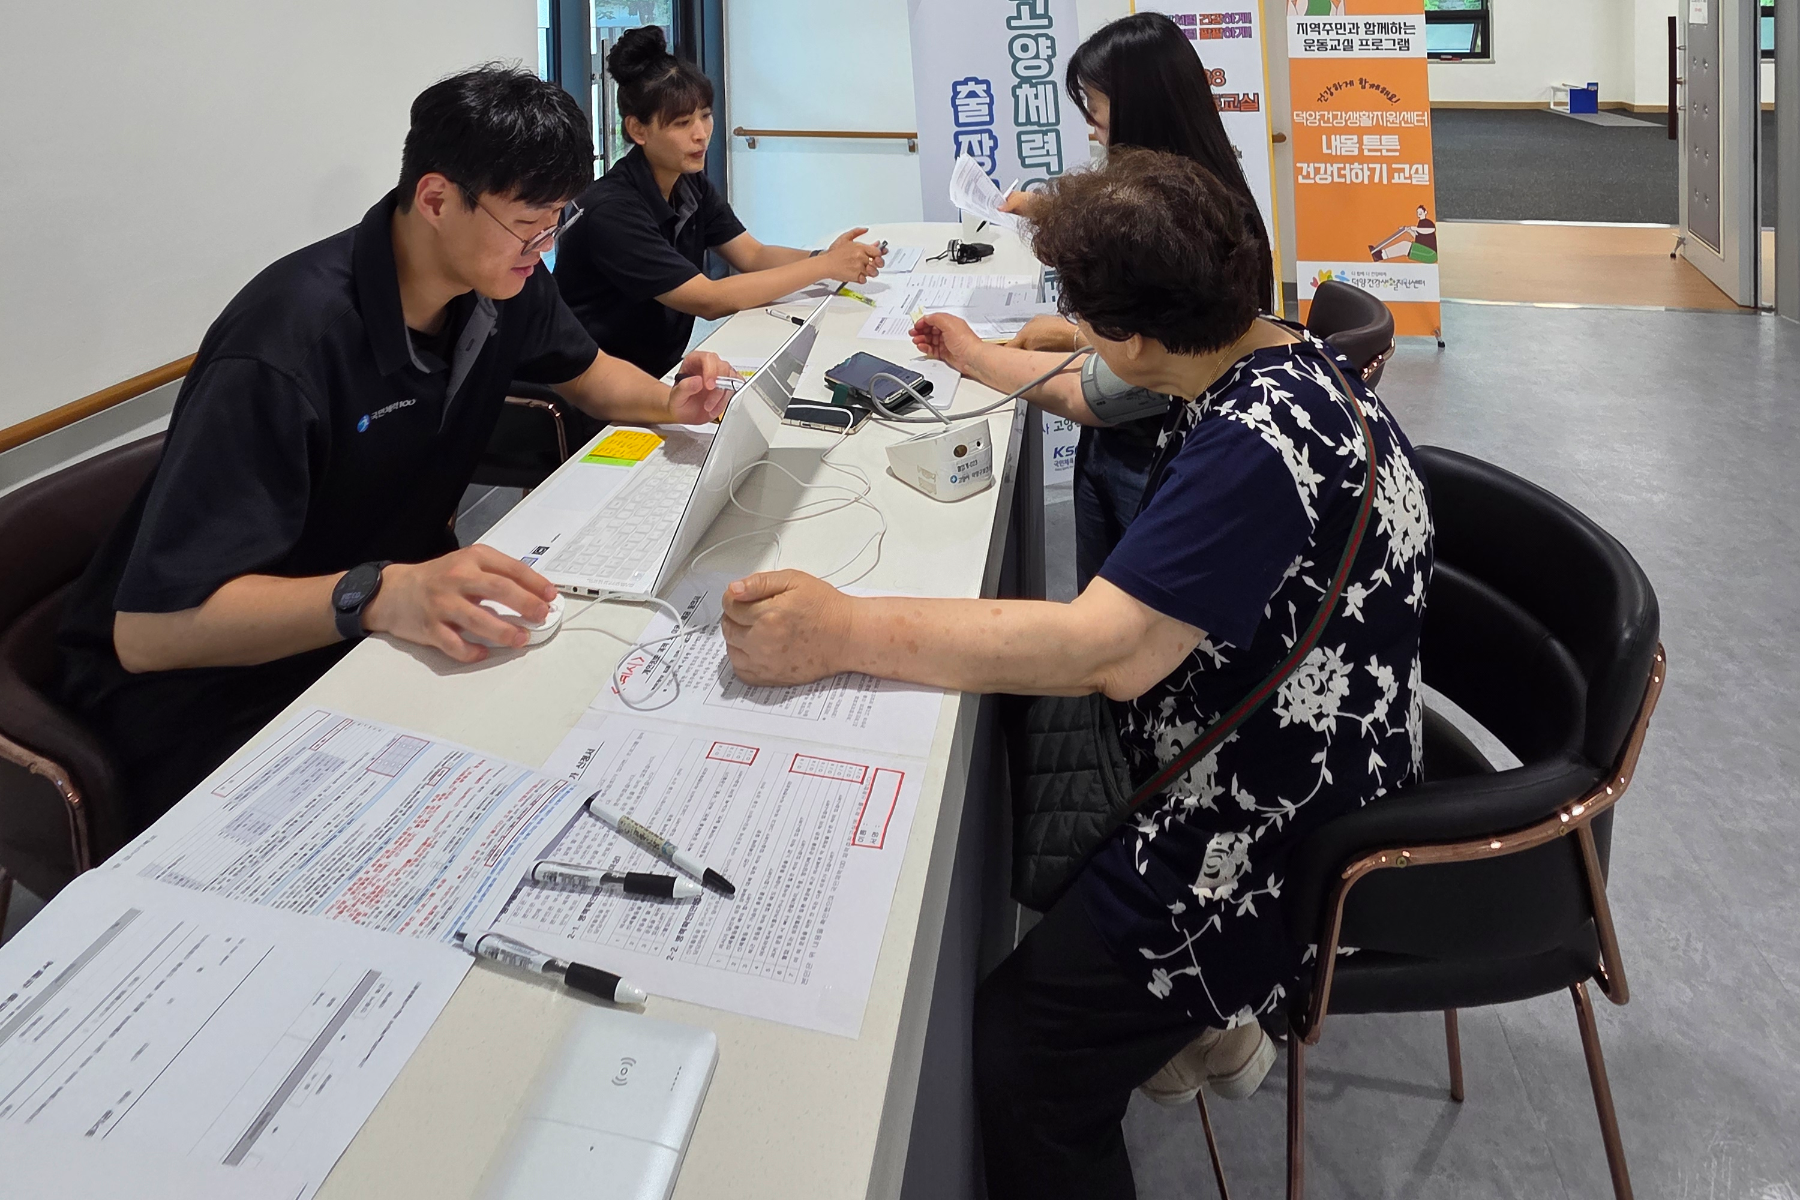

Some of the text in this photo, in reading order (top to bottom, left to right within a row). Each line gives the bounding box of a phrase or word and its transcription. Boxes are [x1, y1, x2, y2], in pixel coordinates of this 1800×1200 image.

[1296, 21, 1417, 36] 지역주민과 함께하는
[1303, 38, 1410, 52] 운동교실 프로그램
[1316, 77, 1401, 106] 건강하게 함께해요!
[1293, 110, 1429, 128] 덕양건강생활지원센터
[1321, 134, 1401, 156] 내몸 튼튼
[1296, 162, 1430, 185] 건강더하기 교실
[575, 745, 595, 769] 신청서
